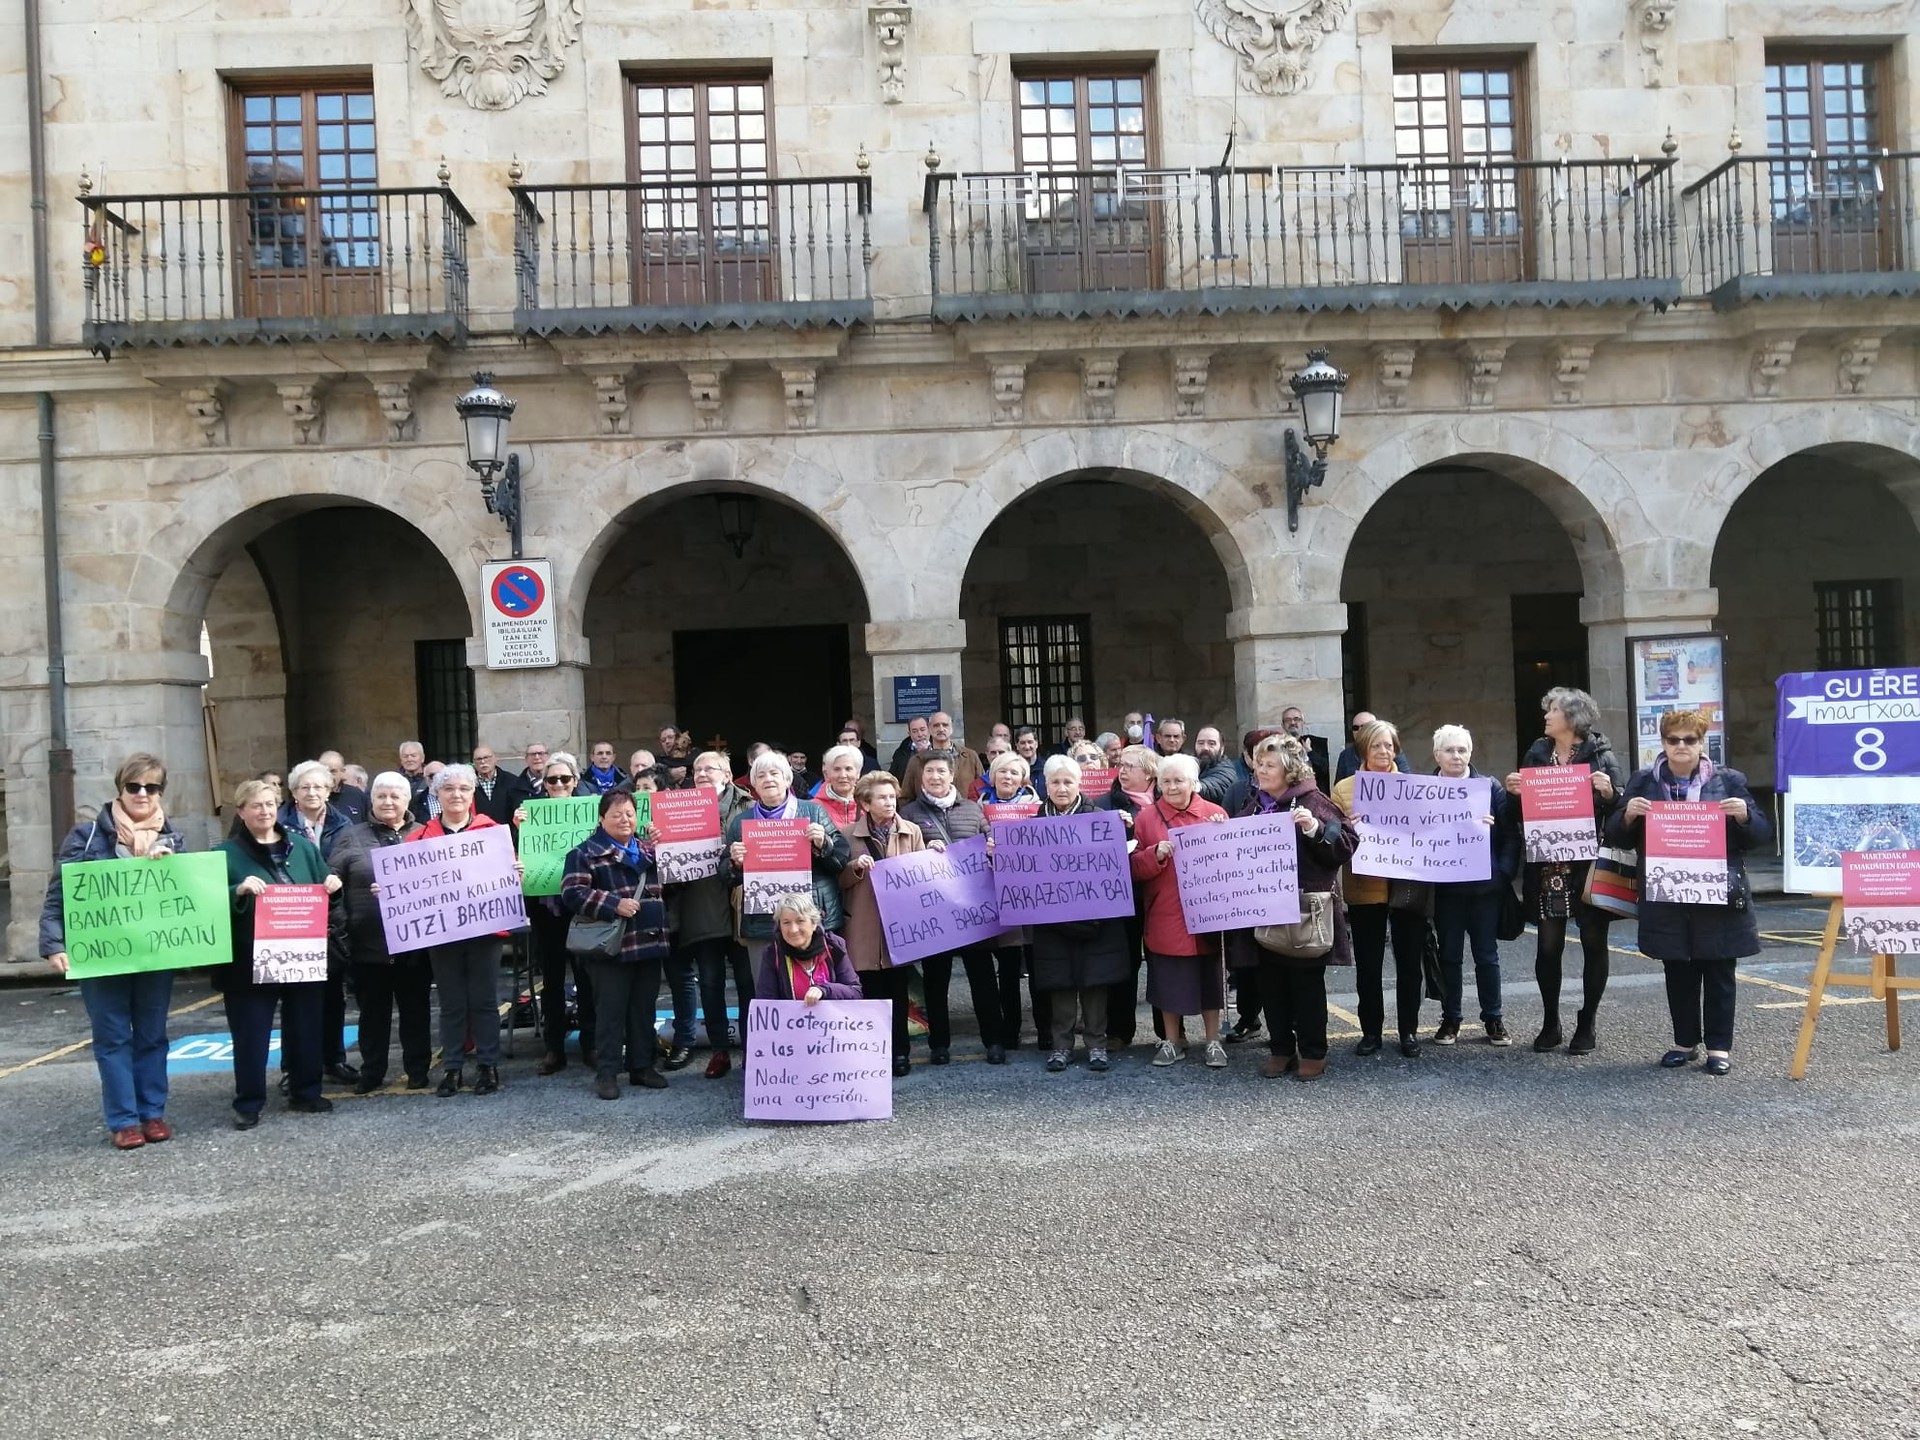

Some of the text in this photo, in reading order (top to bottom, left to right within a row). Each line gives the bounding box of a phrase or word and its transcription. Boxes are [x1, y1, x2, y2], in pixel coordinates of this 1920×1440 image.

[492, 619, 548, 627] BAIMENDUTAKO
[498, 657, 550, 665] AUTORIZADOS
[1825, 674, 1918, 698] GU ERE
[1853, 728, 1887, 771] 8
[1360, 777, 1468, 801] NO JUZGUES
[1360, 814, 1371, 824] a
[1380, 815, 1409, 826] una
[1091, 821, 1114, 842] EZ
[1175, 824, 1281, 850] Toma conciencia
[1412, 832, 1423, 848] lo
[1428, 839, 1450, 852] que
[1457, 833, 1484, 845] hizo
[460, 840, 486, 858] BAT
[994, 852, 1043, 873] DAUDE
[1182, 860, 1188, 874] y
[1192, 851, 1229, 868] supera
[72, 869, 177, 902] ZAINTZAK
[386, 869, 462, 900] IKUSTEN
[1182, 869, 1244, 890] estereotipos
[1247, 869, 1254, 881] y
[1232, 879, 1294, 898] machistas
[920, 889, 944, 908] ETA
[1000, 876, 1129, 910] ARRAZISTAK BAI
[69, 895, 196, 930] BANATU ETA
[396, 894, 525, 942] UTZI BAKEAN!
[72, 919, 216, 963] ONDO PAGATU
[889, 917, 944, 948] ELKAR
[786, 1011, 874, 1037] categorices
[755, 1050, 765, 1058] a
[772, 1041, 794, 1057] las
[755, 1068, 887, 1087] Nadie se merece
[754, 1088, 868, 1109] una agresión.
